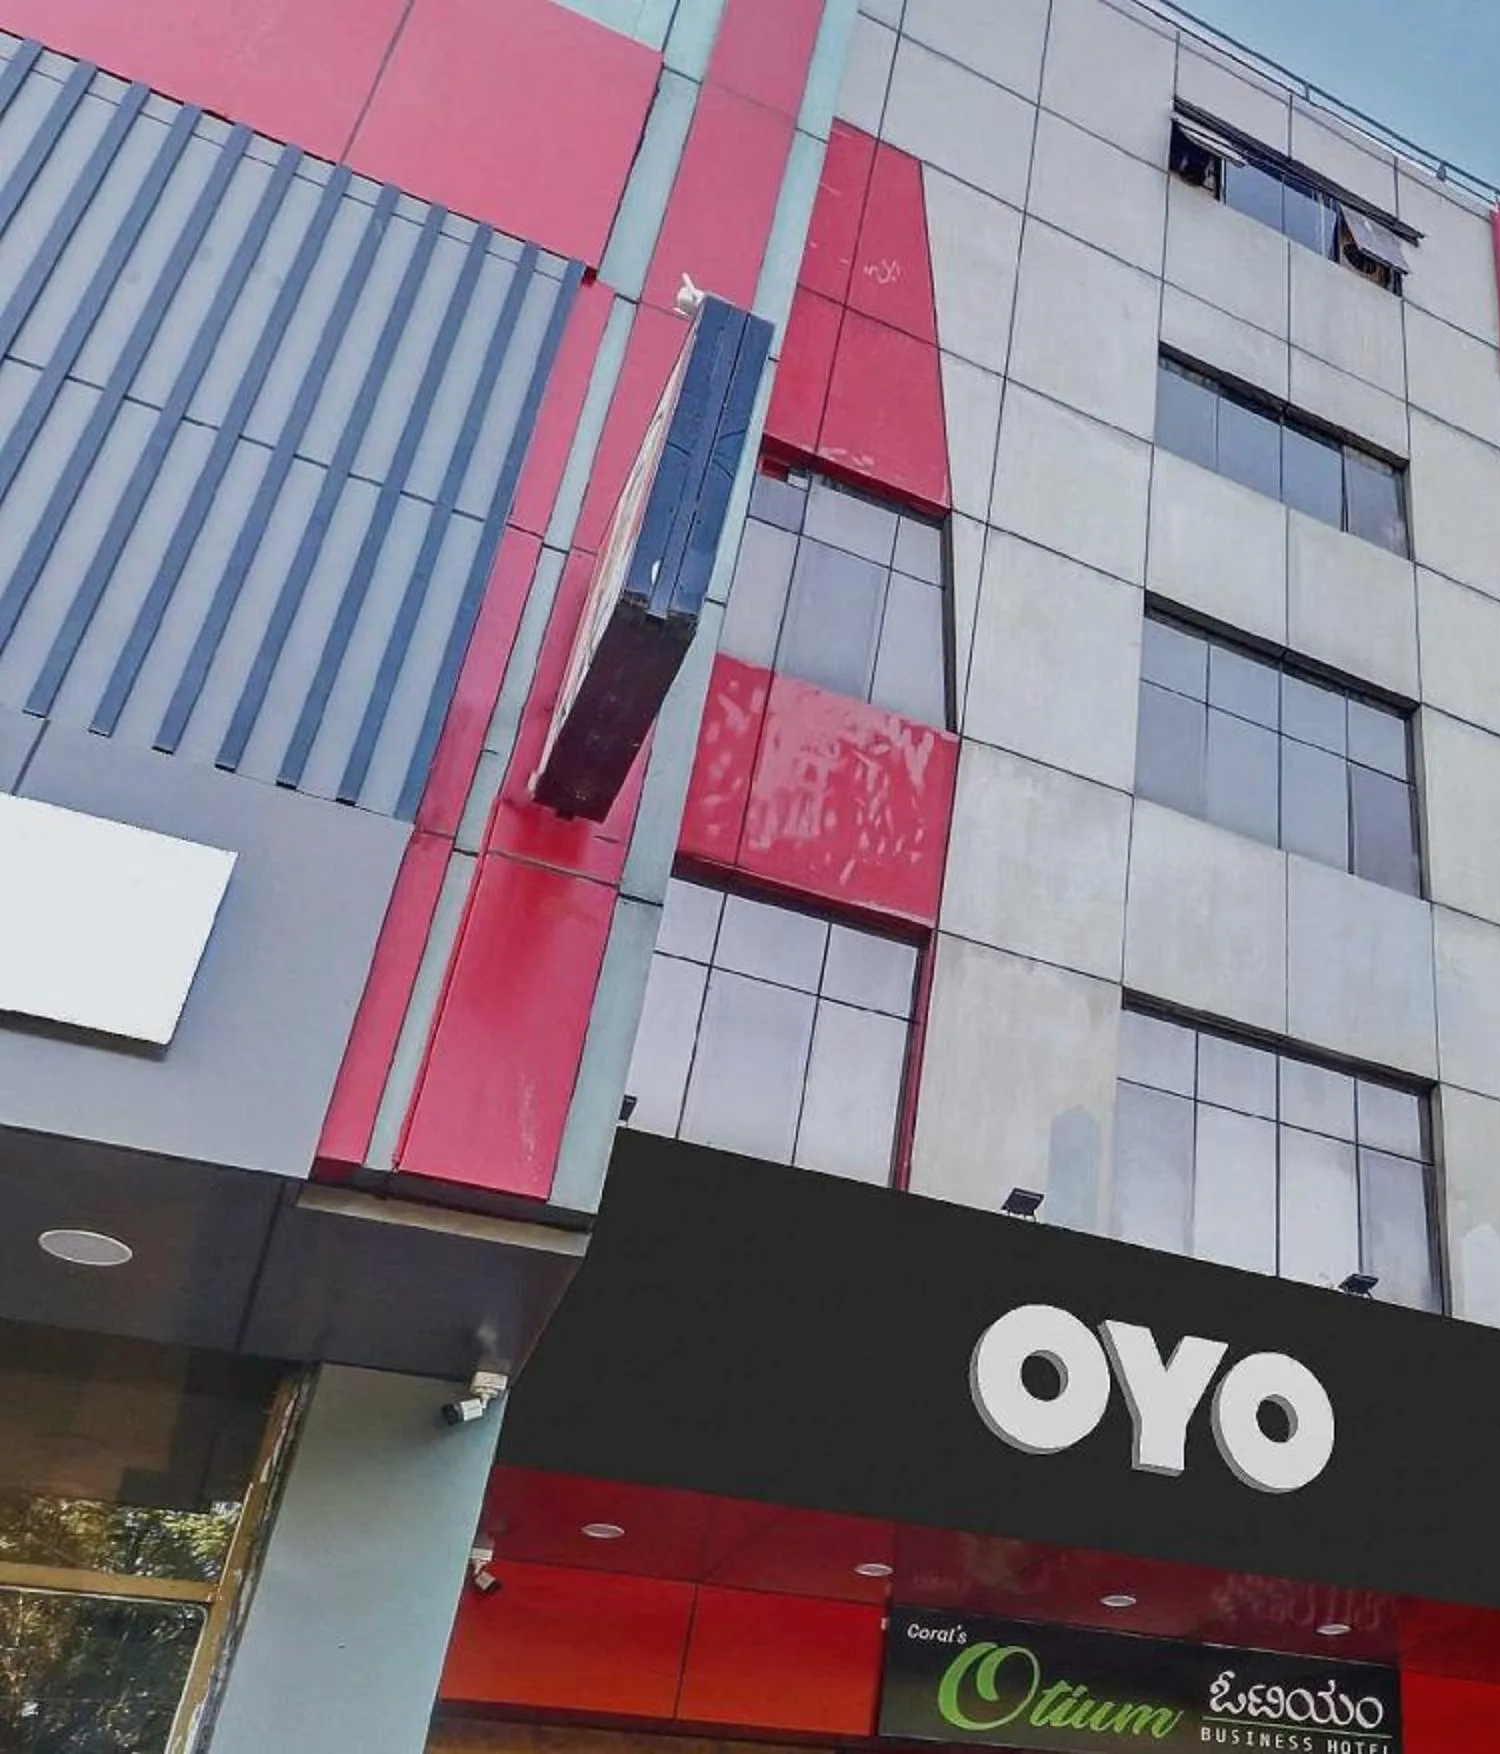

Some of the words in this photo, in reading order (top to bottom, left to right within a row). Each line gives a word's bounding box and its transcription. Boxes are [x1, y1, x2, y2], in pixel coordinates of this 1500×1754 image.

[969, 1303, 1335, 1493] OYO
[907, 1623, 968, 1645] Coral's
[938, 1641, 1185, 1739] Otium
[1201, 1727, 1313, 1752] BUSINESS
